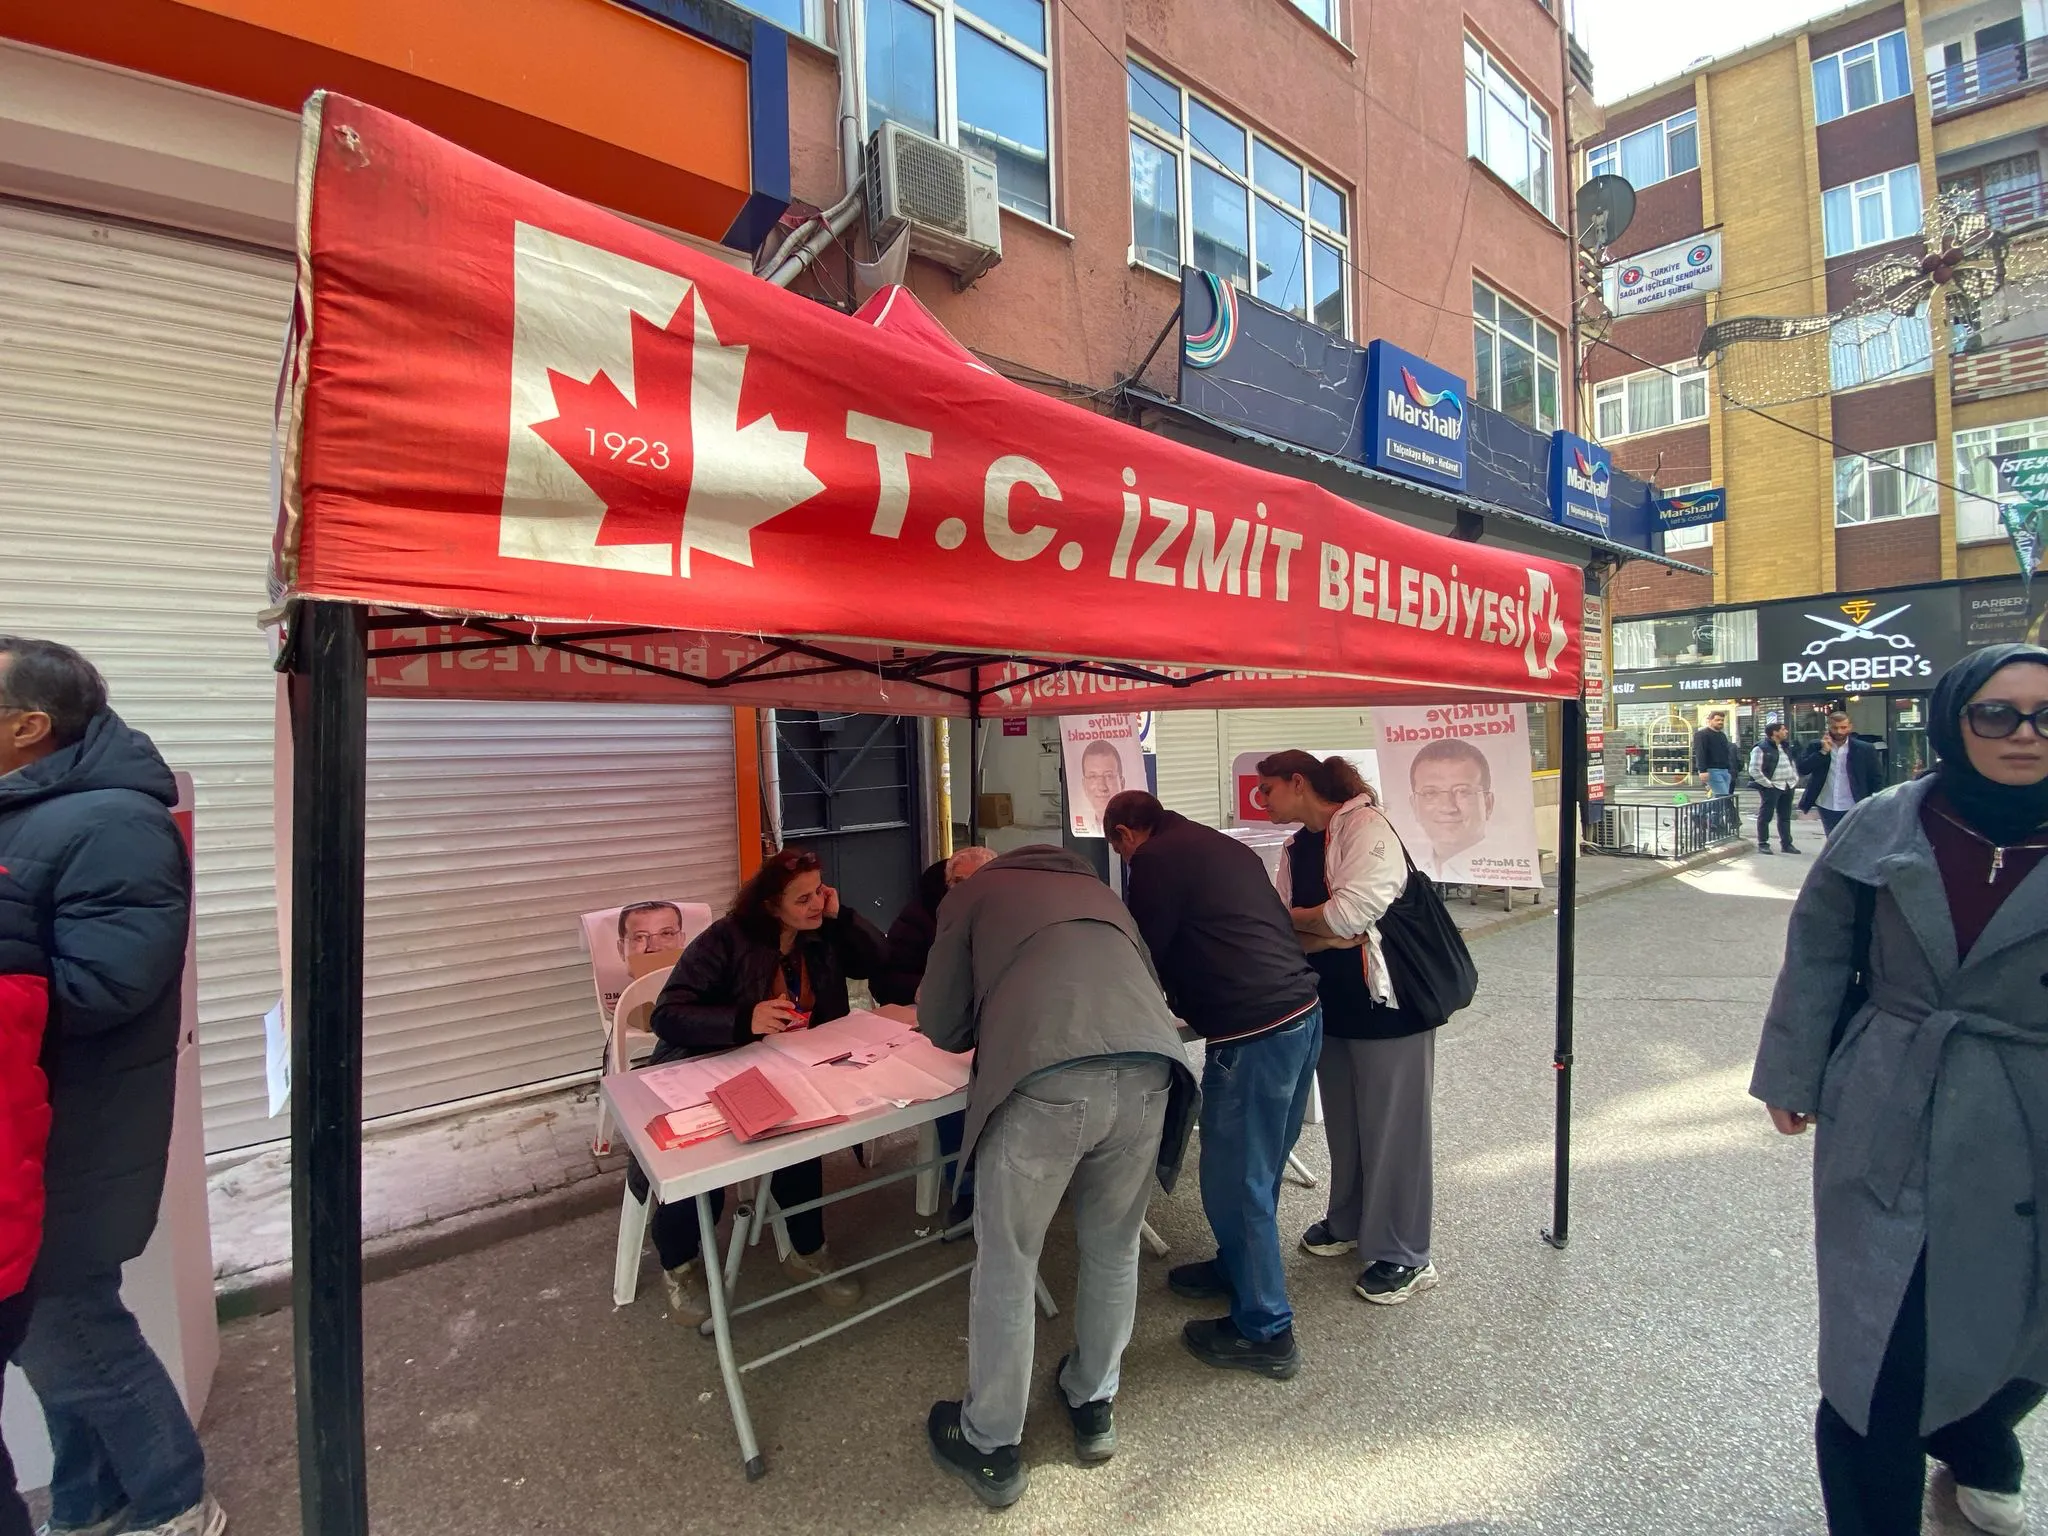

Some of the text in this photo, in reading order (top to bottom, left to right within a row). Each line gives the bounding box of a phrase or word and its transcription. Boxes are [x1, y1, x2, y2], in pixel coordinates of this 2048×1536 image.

[1650, 262, 1680, 277] TÜRKİYE
[1619, 264, 1713, 299] SAĞLIK İŞÇİLERİ SENDİKASI
[1637, 289, 1667, 305] KOCAELİ
[1387, 390, 1459, 441] Marshall
[584, 426, 671, 471] 1923
[1392, 442, 1422, 461] Yalçınkaya
[1566, 466, 1608, 499] Marshall
[1659, 502, 1716, 520] Marshall
[1687, 513, 1713, 523] colour
[845, 409, 1526, 649] T.C. İZMİT BELEDİYESİ
[1782, 654, 1932, 684] BARBER's
[1712, 676, 1742, 690] ŞAHİN
[1843, 681, 1871, 691] club
